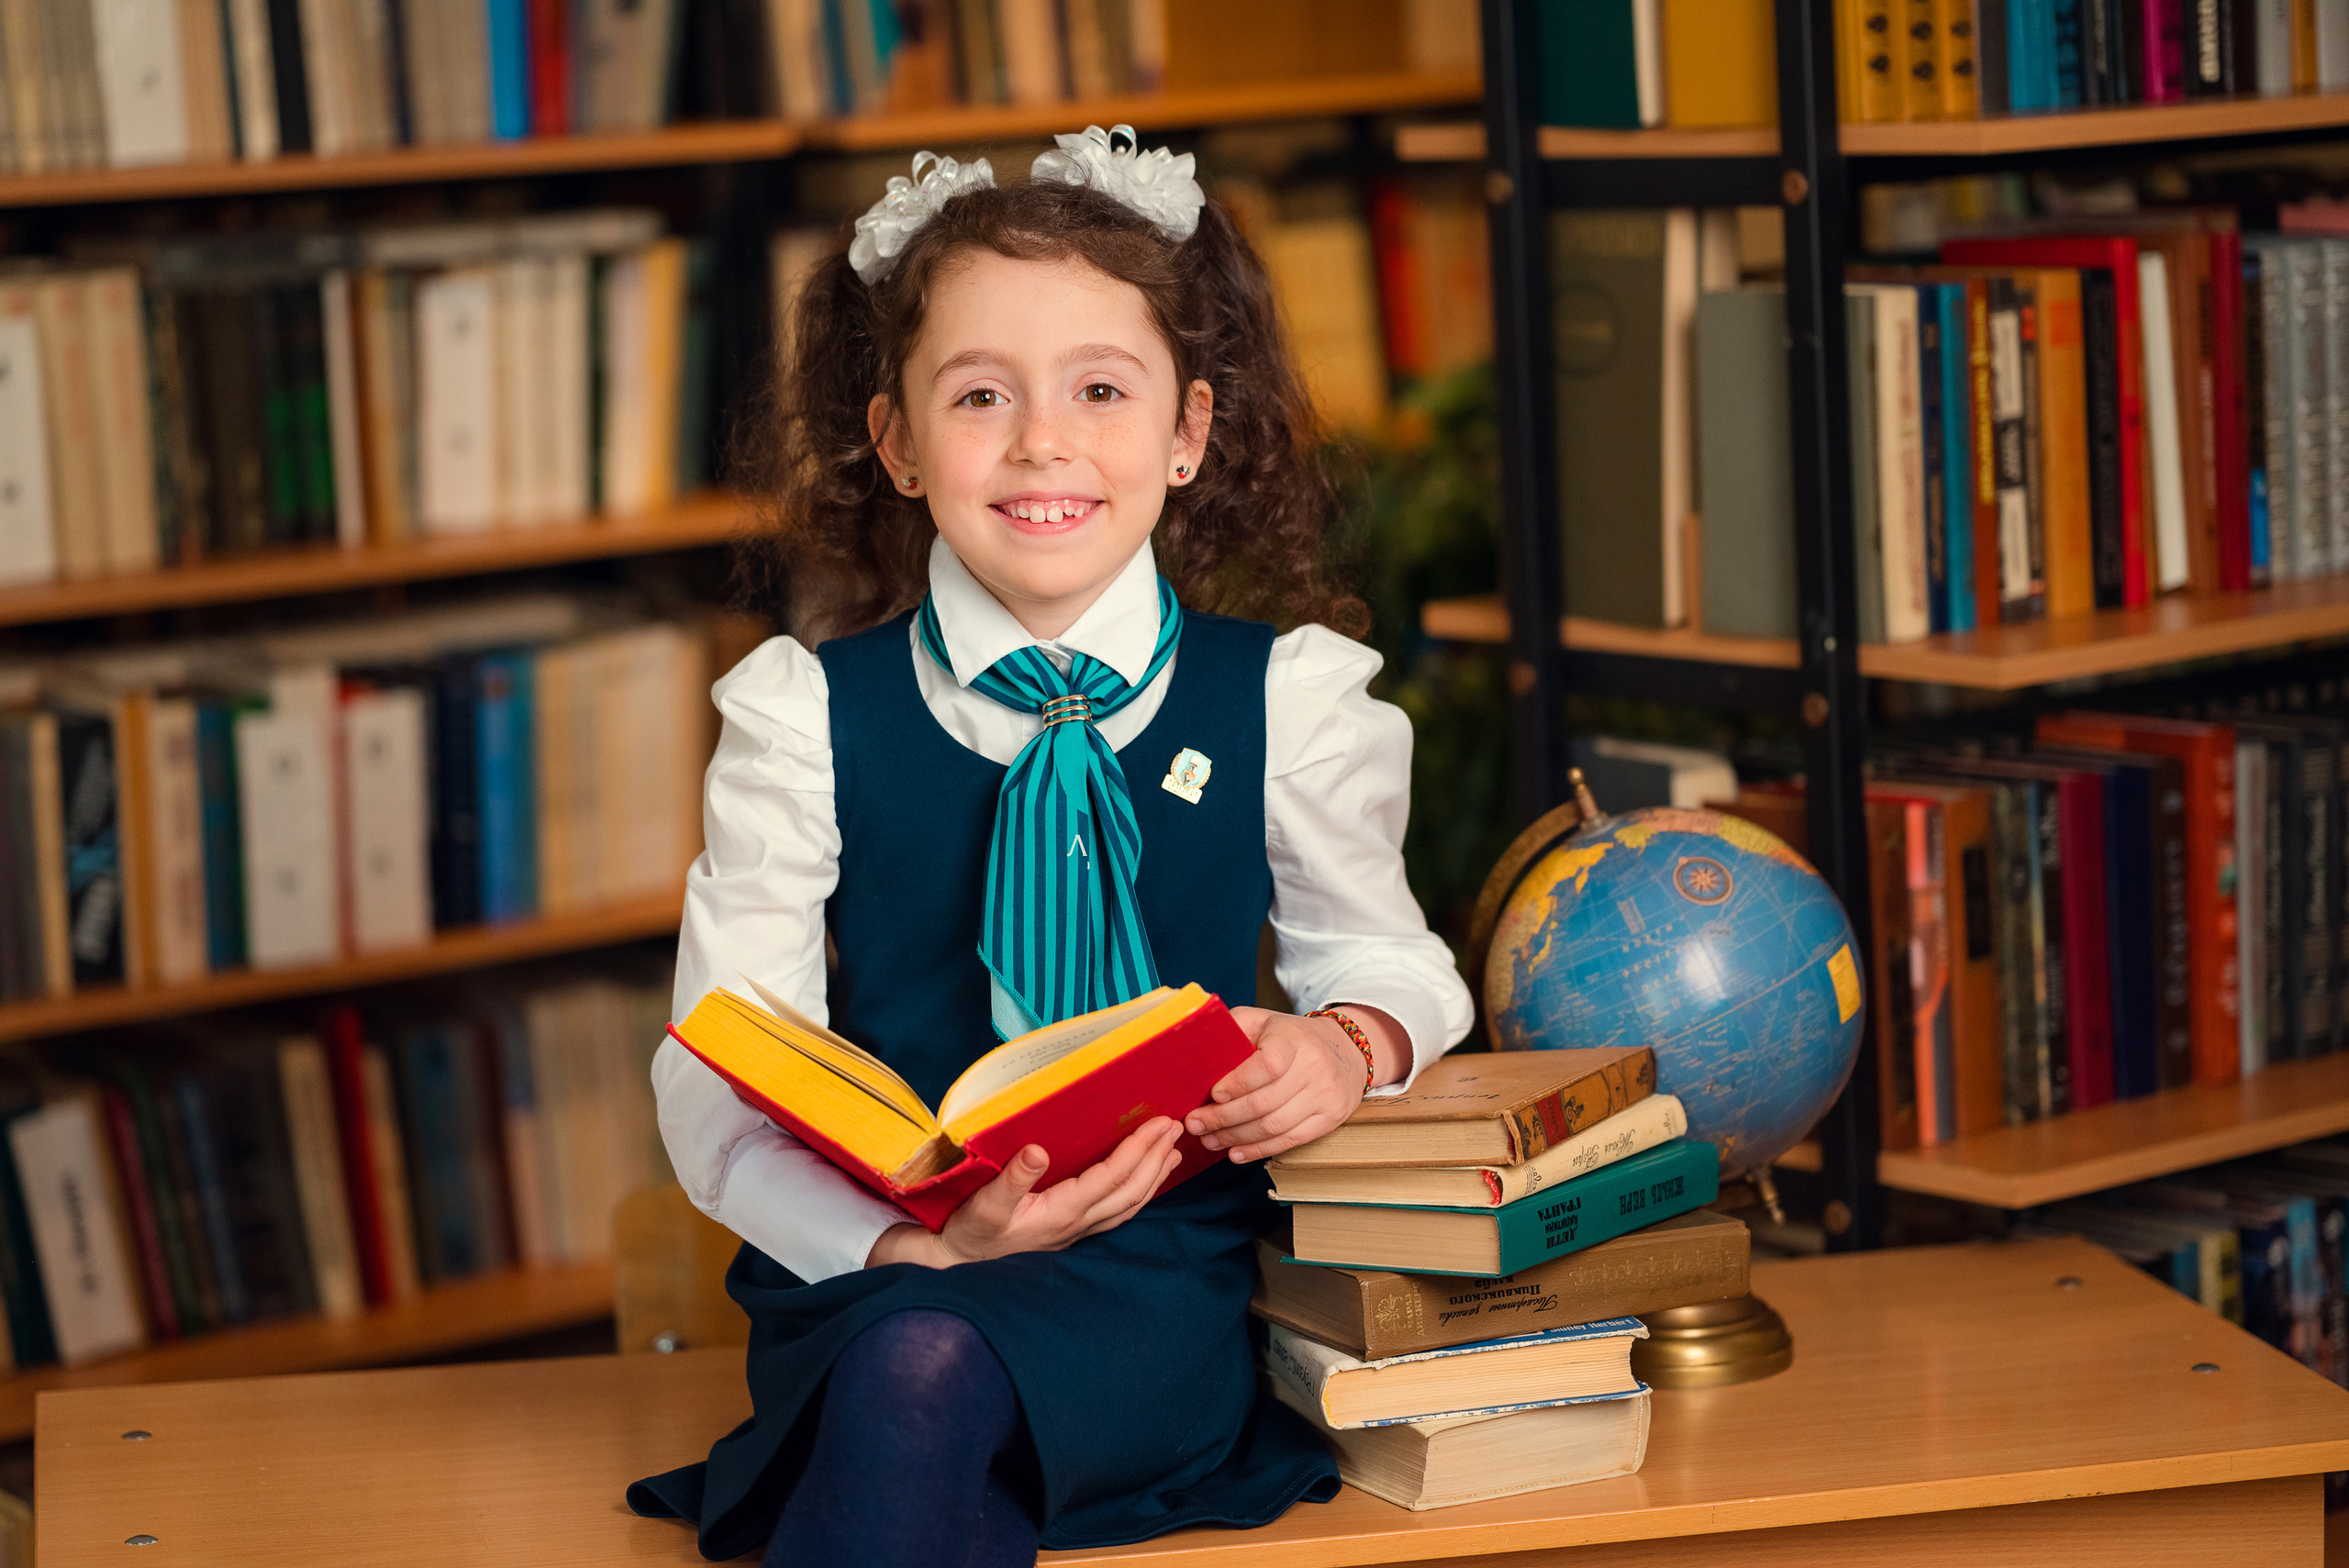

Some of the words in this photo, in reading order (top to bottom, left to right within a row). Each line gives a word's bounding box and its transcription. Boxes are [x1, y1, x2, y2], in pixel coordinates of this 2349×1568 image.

[1651, 1175, 1685, 1205] ЖЮЛЬ
[1537, 1196, 1582, 1222] ГРАНТА
[1620, 1187, 1645, 1216] ВЕРН
[1544, 1214, 1578, 1234] КАПИТАНА
[1545, 1228, 1577, 1250] ДЕТИ
[1449, 1284, 1542, 1306] Пиквикского
[1488, 1294, 1558, 1314] Посмертные
